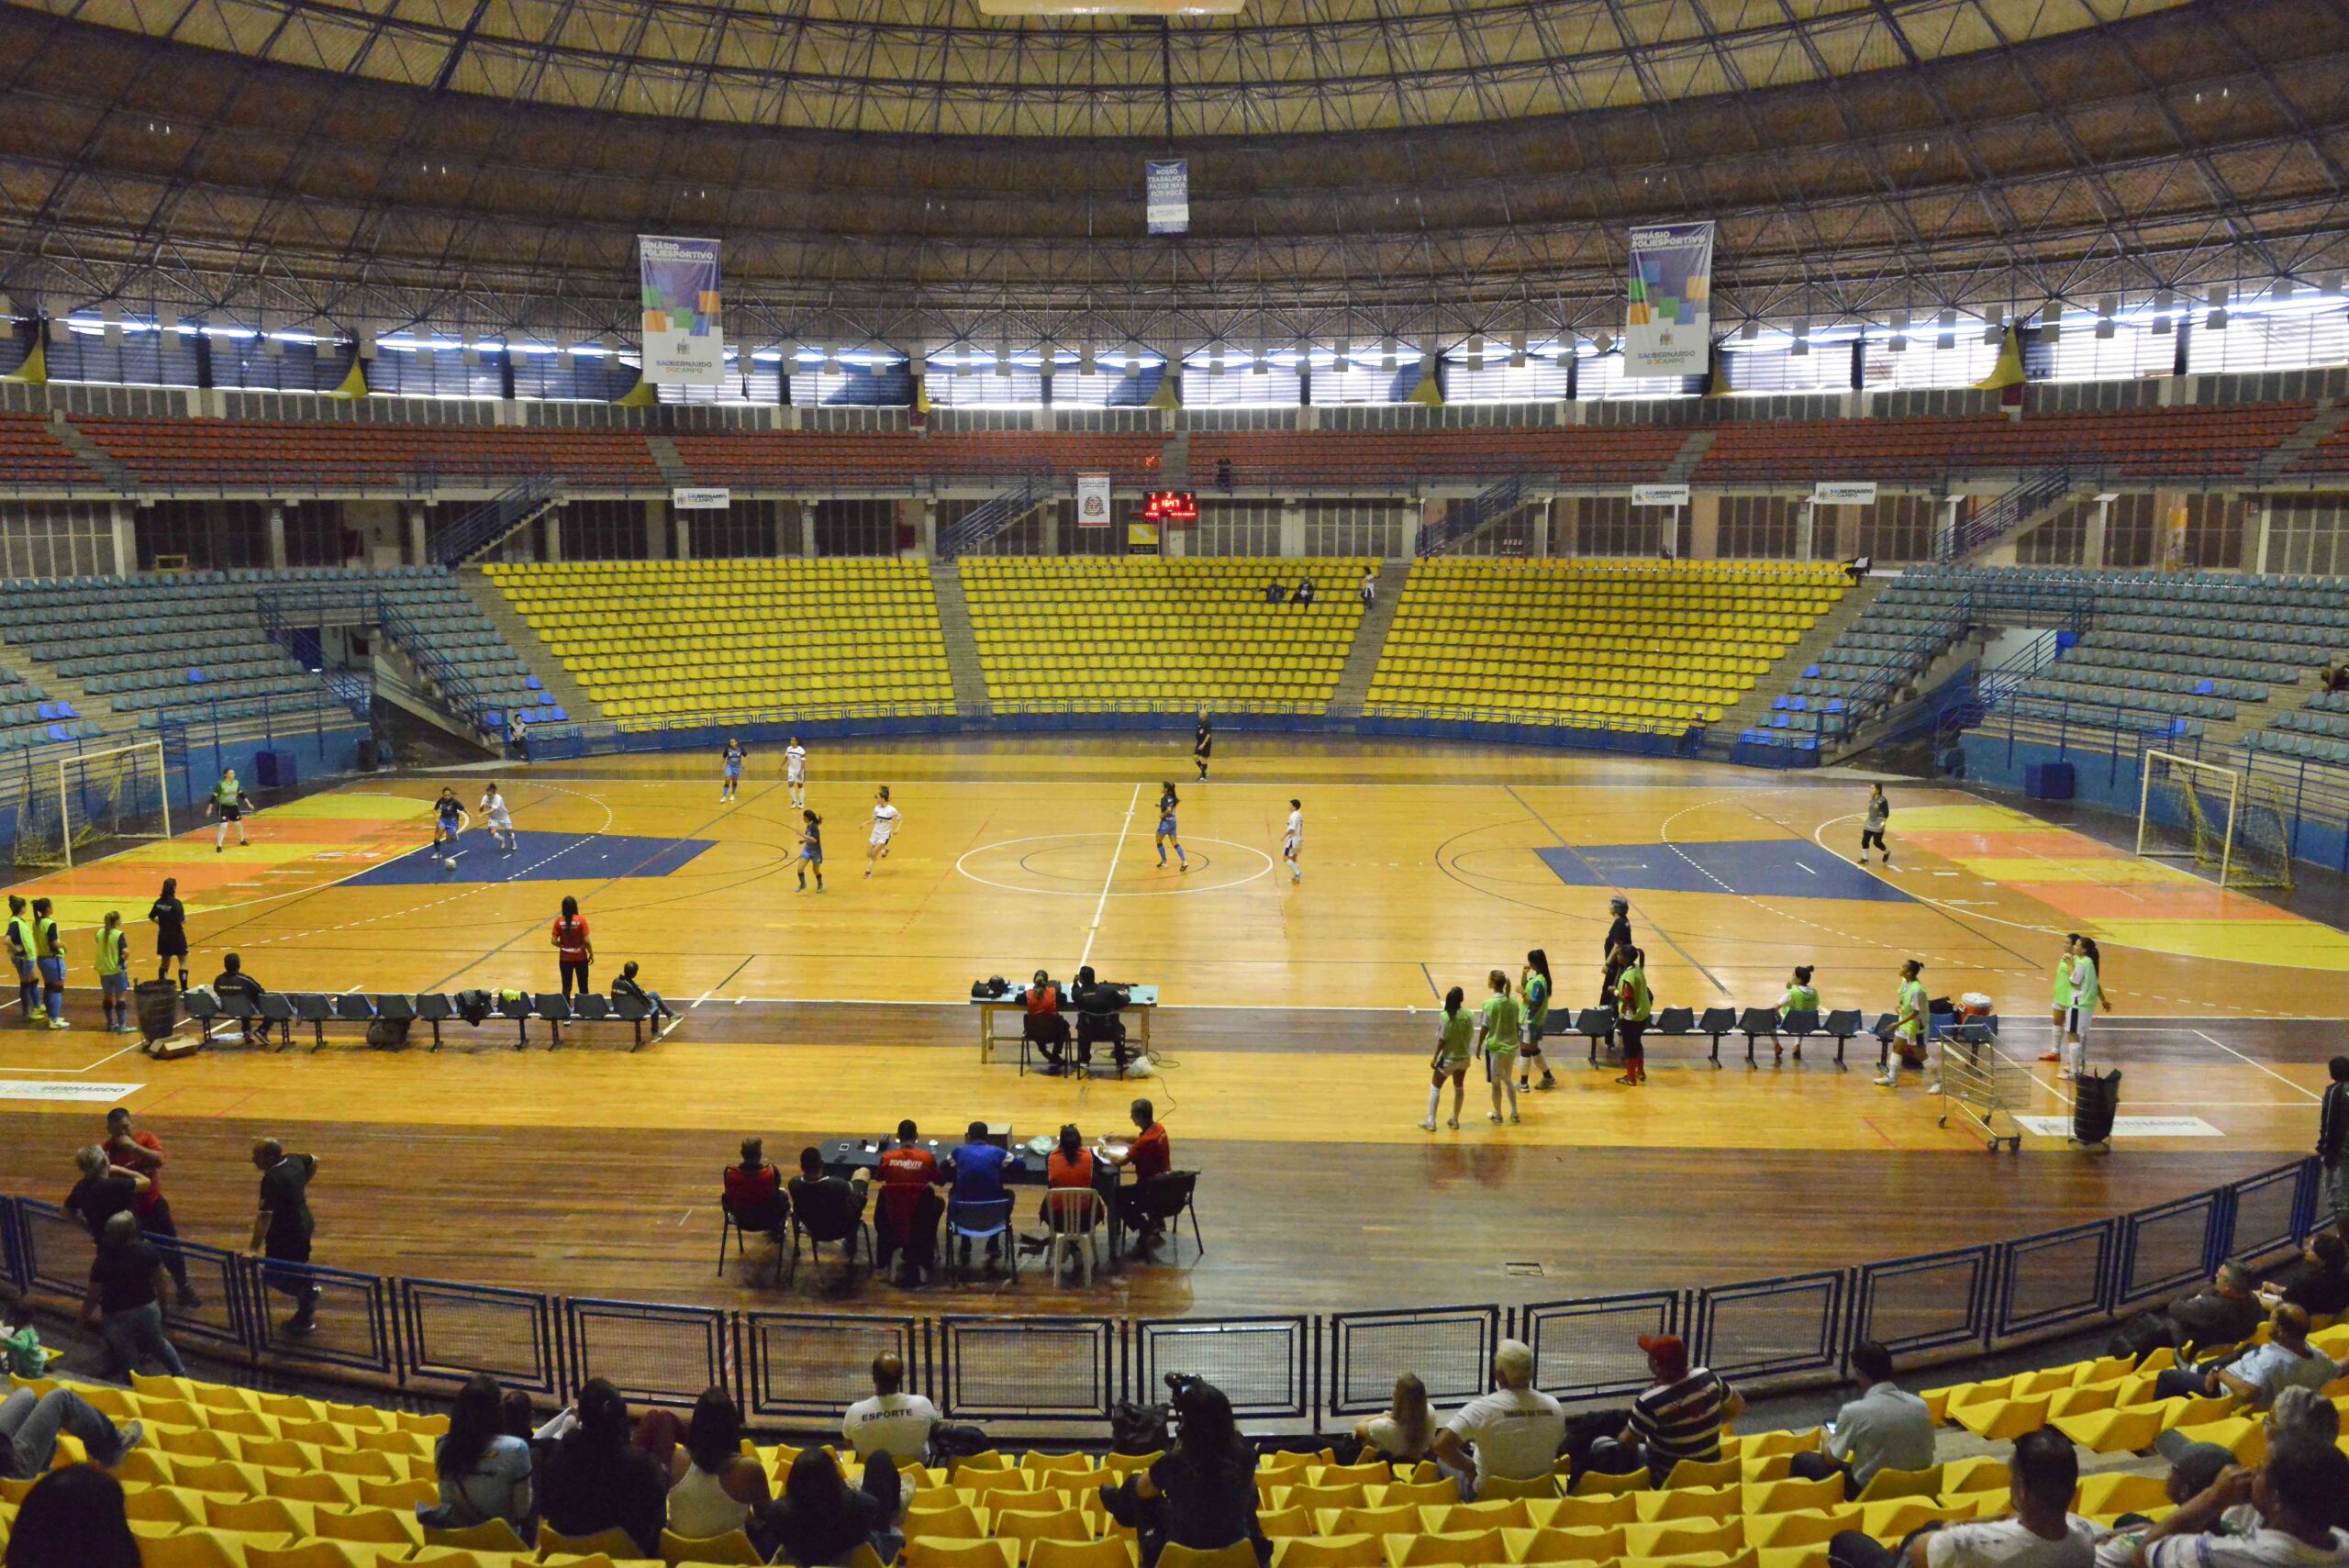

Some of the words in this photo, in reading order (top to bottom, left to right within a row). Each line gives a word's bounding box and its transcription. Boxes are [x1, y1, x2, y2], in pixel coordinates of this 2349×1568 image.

[1631, 230, 1670, 241] GINÁSIO
[640, 240, 679, 250] GINÁSIO
[1631, 235, 1706, 249] POLIESPORTIVO
[640, 249, 714, 260] POLIESPORTIVO
[862, 1408, 912, 1421] ESPORTE
